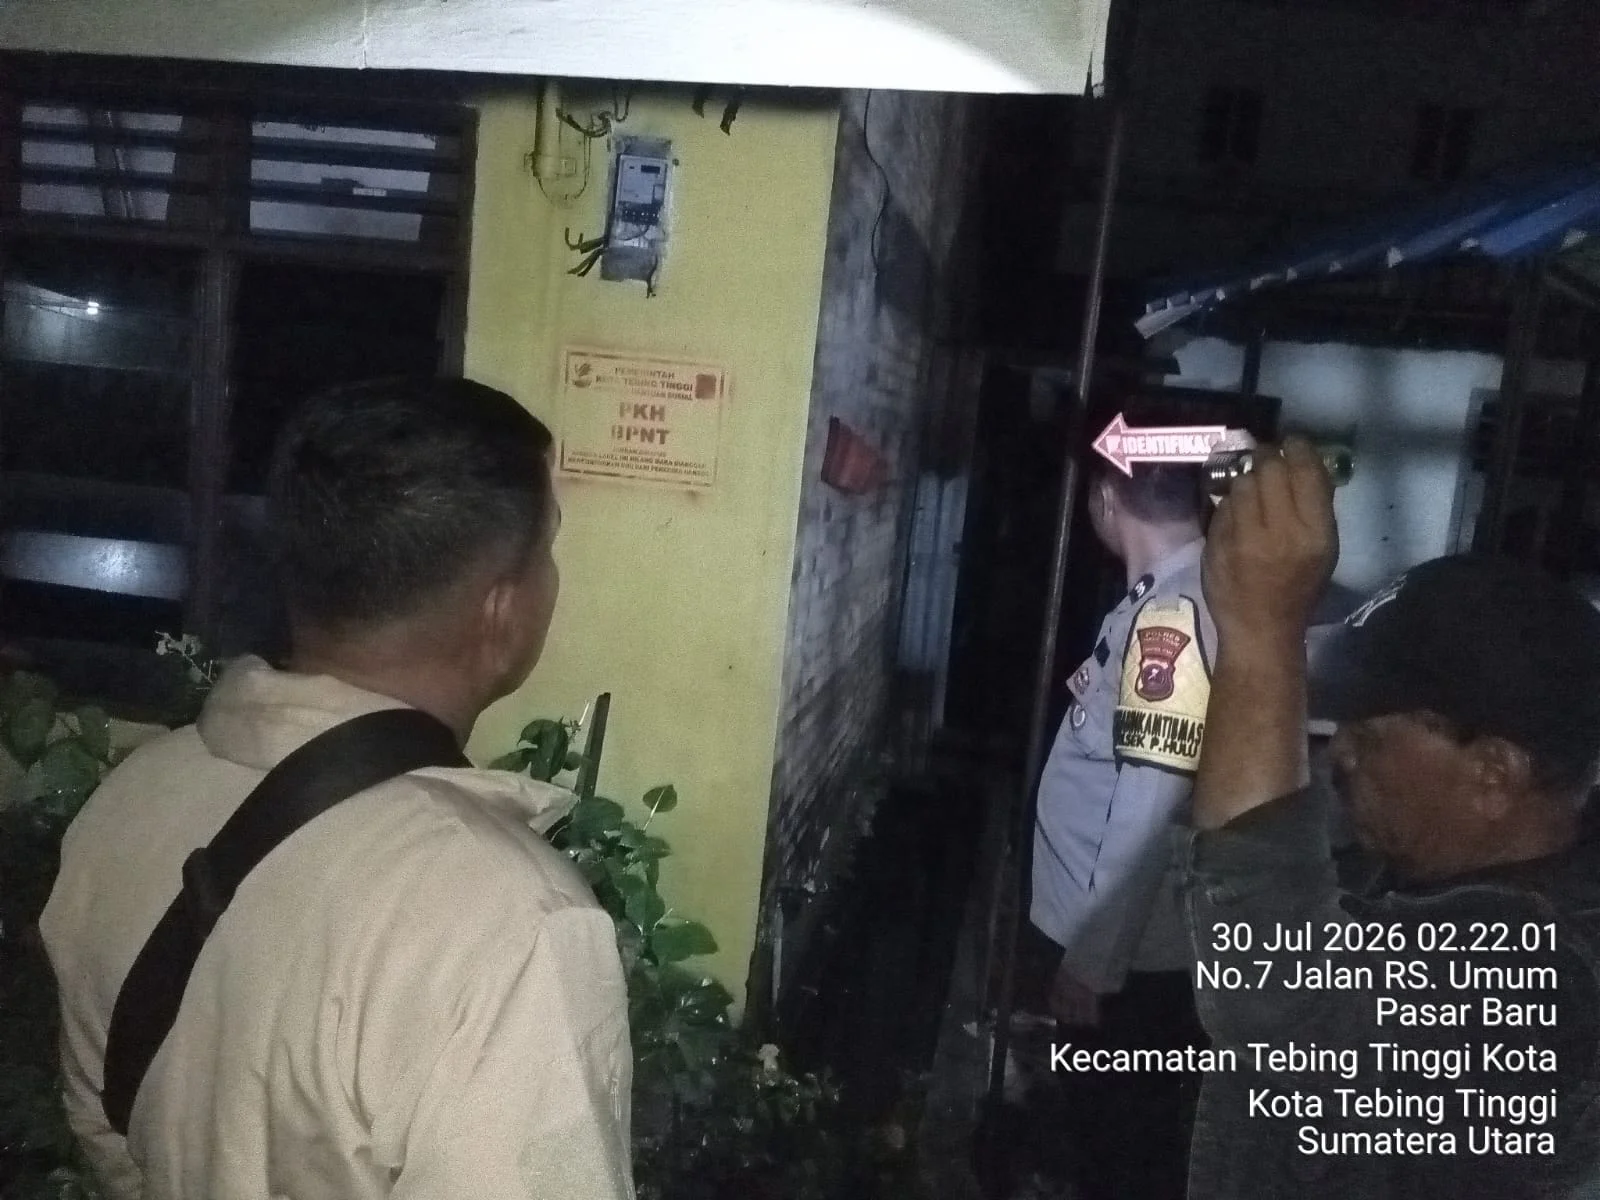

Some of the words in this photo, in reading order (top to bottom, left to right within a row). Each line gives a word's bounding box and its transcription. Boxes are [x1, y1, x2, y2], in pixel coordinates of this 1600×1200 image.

[659, 380, 693, 392] TINGGI
[619, 402, 666, 422] PKH
[611, 425, 670, 445] BPNT
